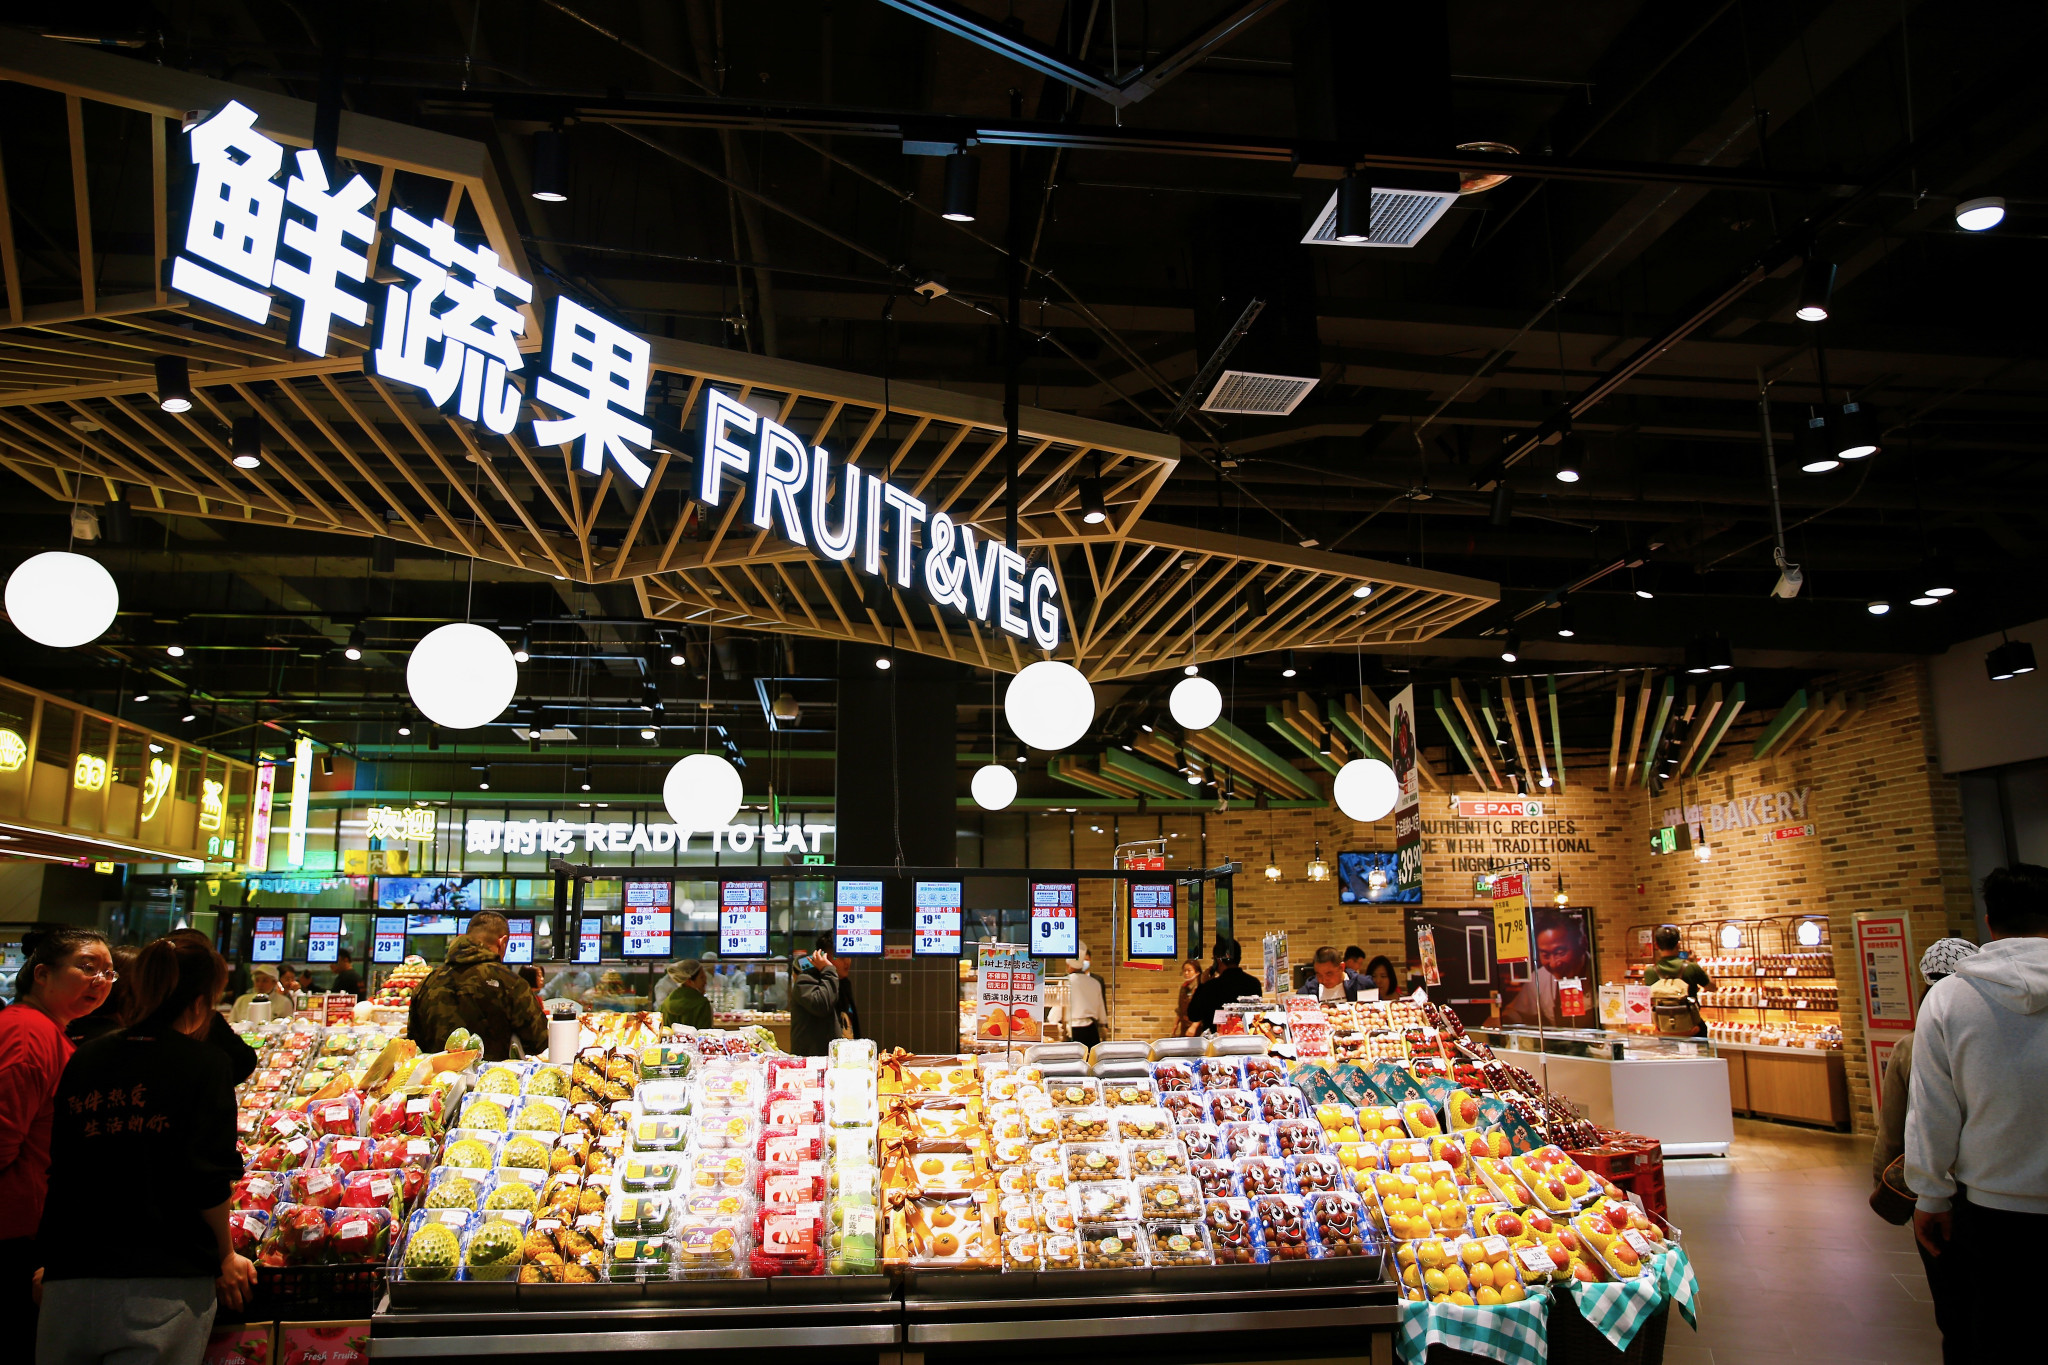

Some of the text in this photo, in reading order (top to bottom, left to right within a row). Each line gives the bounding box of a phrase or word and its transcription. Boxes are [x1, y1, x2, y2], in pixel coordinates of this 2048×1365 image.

[171, 99, 653, 489] 鲜蔬果
[701, 387, 1060, 651] FRUIT&VEG
[1474, 803, 1523, 814] SPAR
[1711, 787, 1811, 833] BAKERY
[366, 806, 436, 842] 欢迎
[1420, 820, 1503, 835] AUTHENTIC
[1511, 820, 1576, 835] RECIPES
[1781, 826, 1805, 838] SPAR
[465, 819, 823, 855] 即时吃 READY TO EAT
[1446, 839, 1485, 853] WITH
[1492, 838, 1596, 853] TRADITIONAL
[1451, 857, 1552, 872] INGREDIENTS
[1510, 887, 1522, 895] SALE
[1136, 909, 1169, 918] 智利西梅
[1041, 921, 1065, 938] 9.90
[1137, 921, 1166, 938] 11.98
[1498, 919, 1524, 944] 17.98
[303, 1351, 358, 1361] Fresh Fruits
